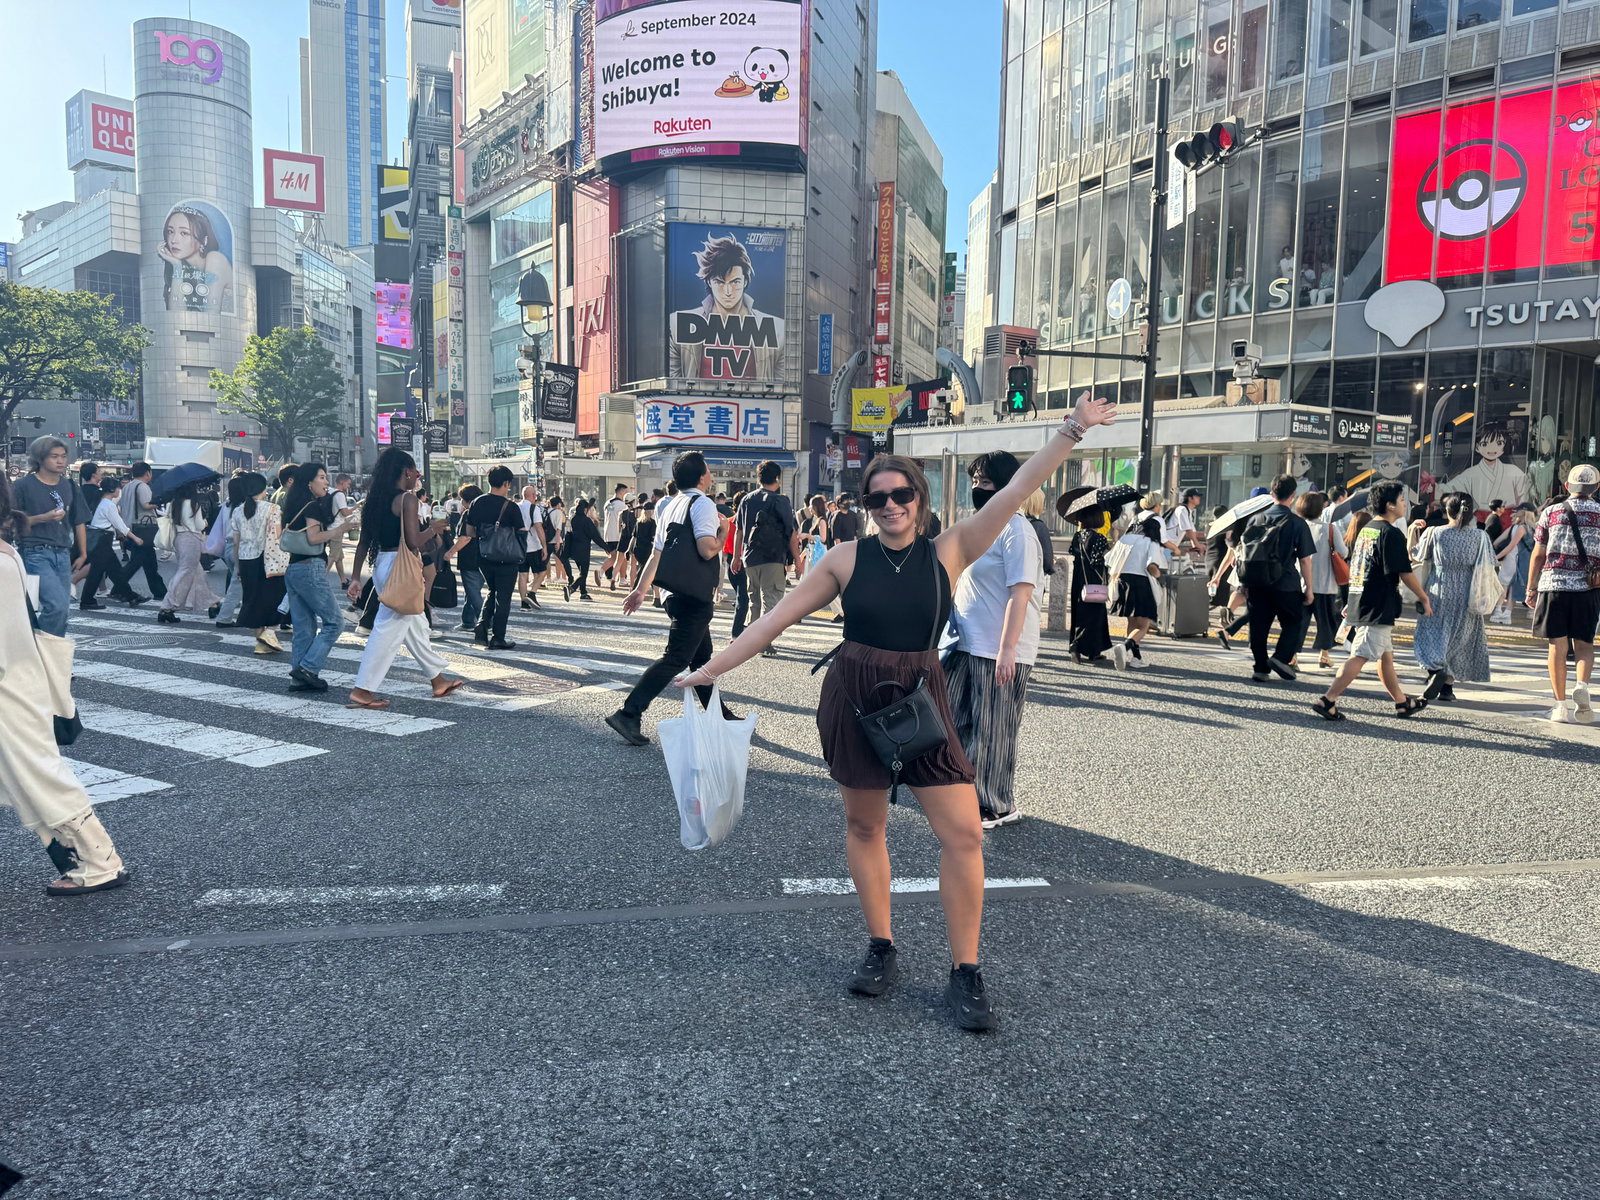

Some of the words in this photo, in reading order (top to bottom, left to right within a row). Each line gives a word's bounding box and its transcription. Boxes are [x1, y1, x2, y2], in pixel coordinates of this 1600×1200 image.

[641, 14, 716, 36] September
[719, 13, 756, 27] 2024
[153, 31, 223, 84] 109
[601, 53, 685, 85] Welcome
[691, 49, 716, 67] to
[601, 78, 680, 112] Shibuya!
[97, 110, 133, 133] UNI
[653, 117, 711, 137] Rakuten
[658, 146, 684, 156] Rakuten
[685, 145, 706, 154] Vision
[280, 169, 310, 192] H&M
[879, 185, 892, 275] クスリのことなら
[1569, 210, 1595, 243] 5
[876, 282, 890, 336] 三千里
[676, 312, 778, 348] DMM
[704, 348, 750, 377] TV
